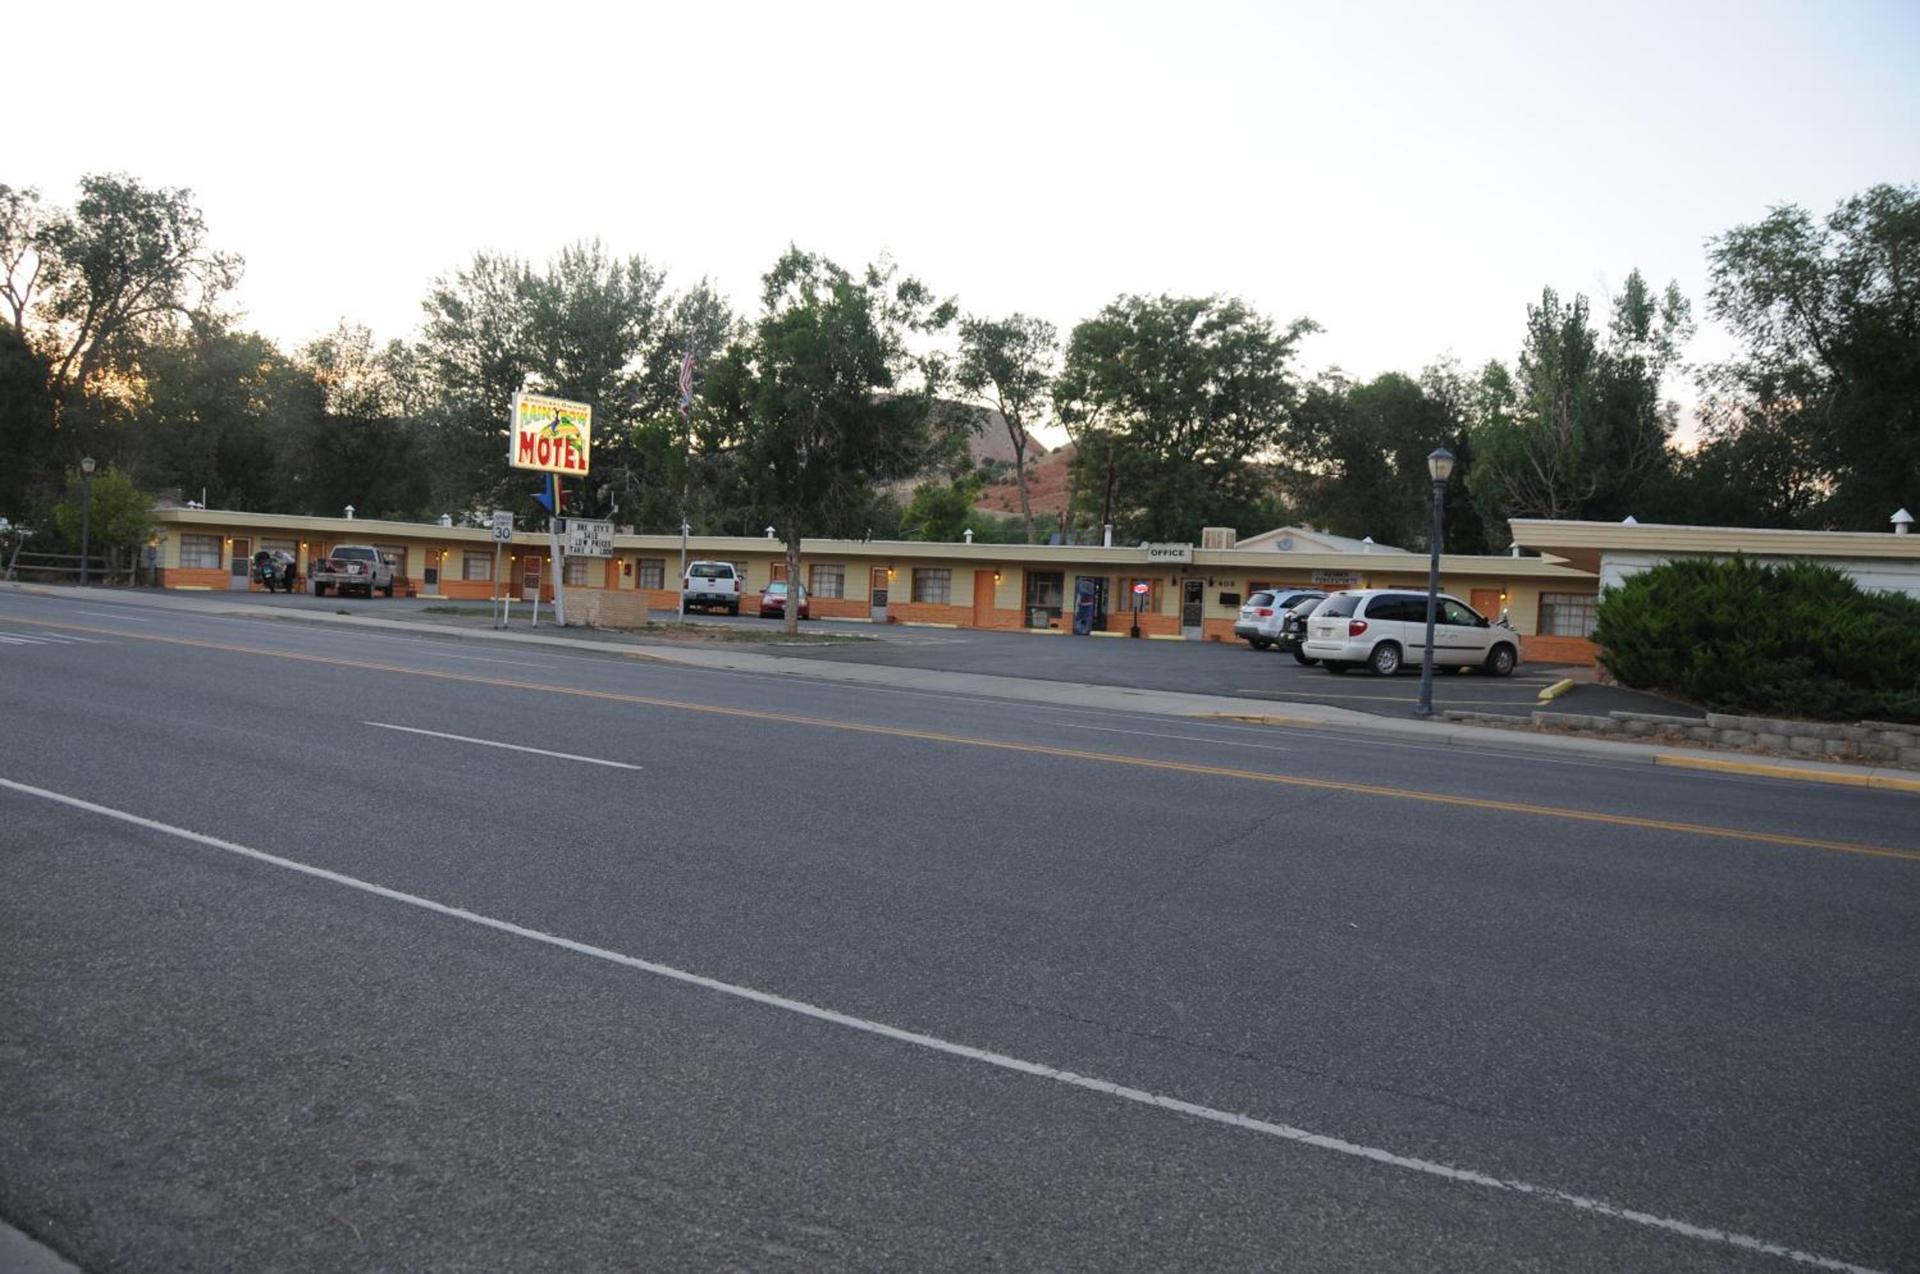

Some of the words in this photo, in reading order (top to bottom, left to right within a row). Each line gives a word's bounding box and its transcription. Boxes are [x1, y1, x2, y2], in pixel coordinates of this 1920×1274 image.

[518, 431, 587, 470] MOTEL
[495, 527, 510, 539] 30
[584, 531, 599, 540] SALE
[575, 538, 588, 546] LOW
[591, 539, 612, 548] PRICES
[570, 545, 585, 554] TAKE
[600, 547, 613, 555] LOOK
[1151, 548, 1185, 557] OFFICE
